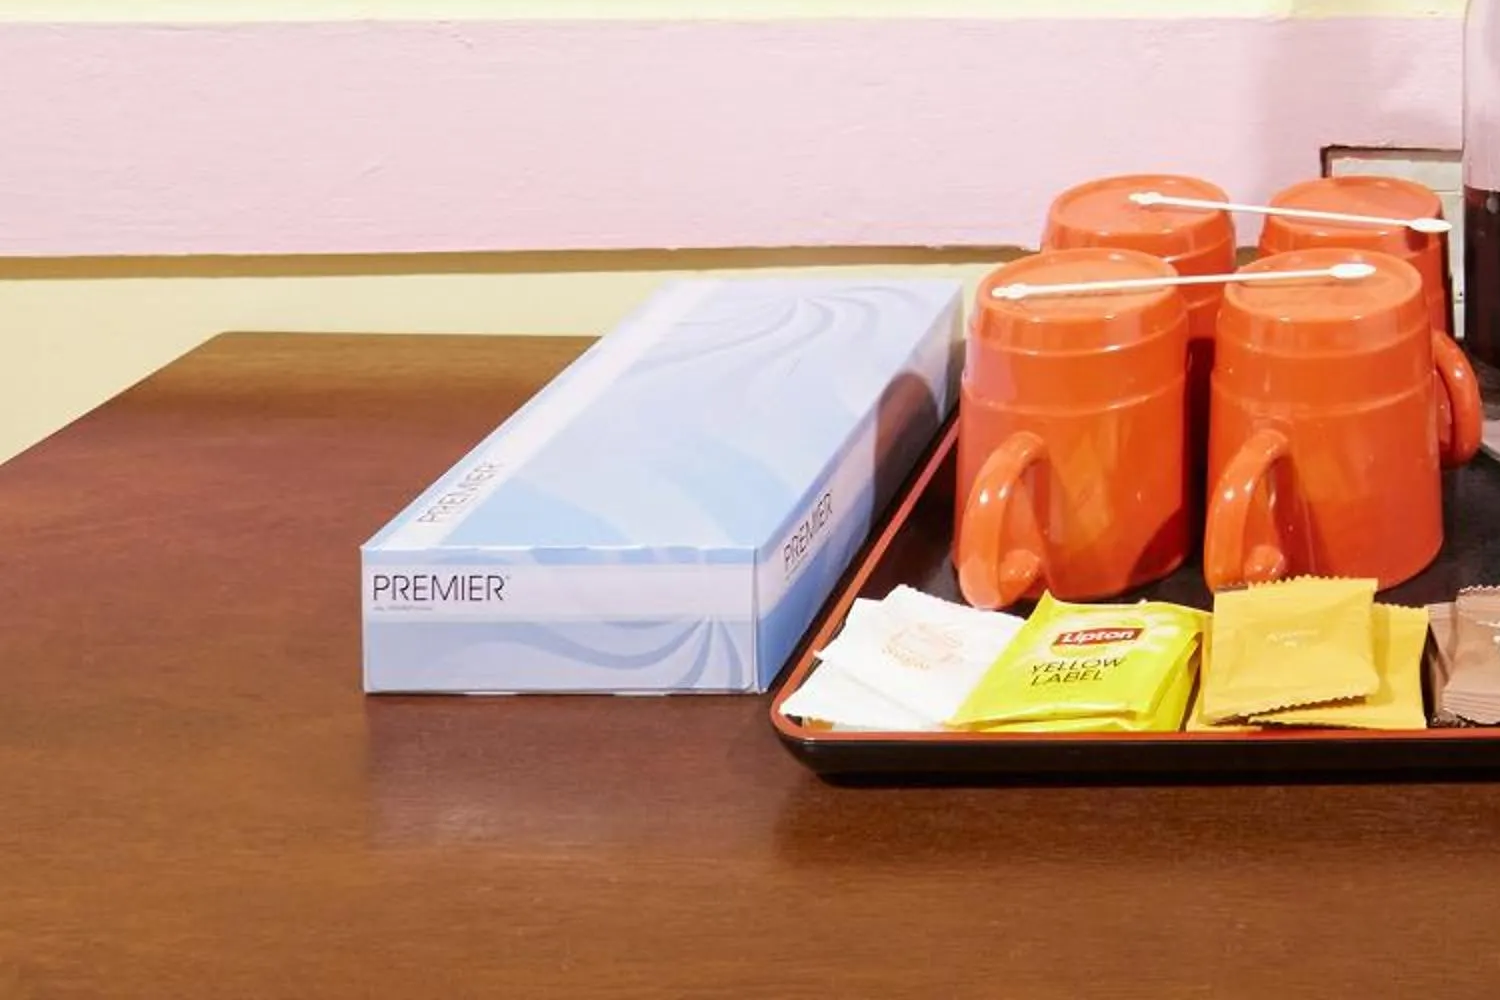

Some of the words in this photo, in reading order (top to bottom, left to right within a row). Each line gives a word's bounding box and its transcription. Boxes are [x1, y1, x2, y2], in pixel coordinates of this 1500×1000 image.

[416, 462, 503, 523] PREMIER
[783, 492, 833, 572] PREMIER
[372, 574, 505, 602] PREMIER
[1059, 629, 1136, 646] Lipton
[1031, 657, 1128, 674] YELLOW
[1031, 669, 1103, 686] LABEL
